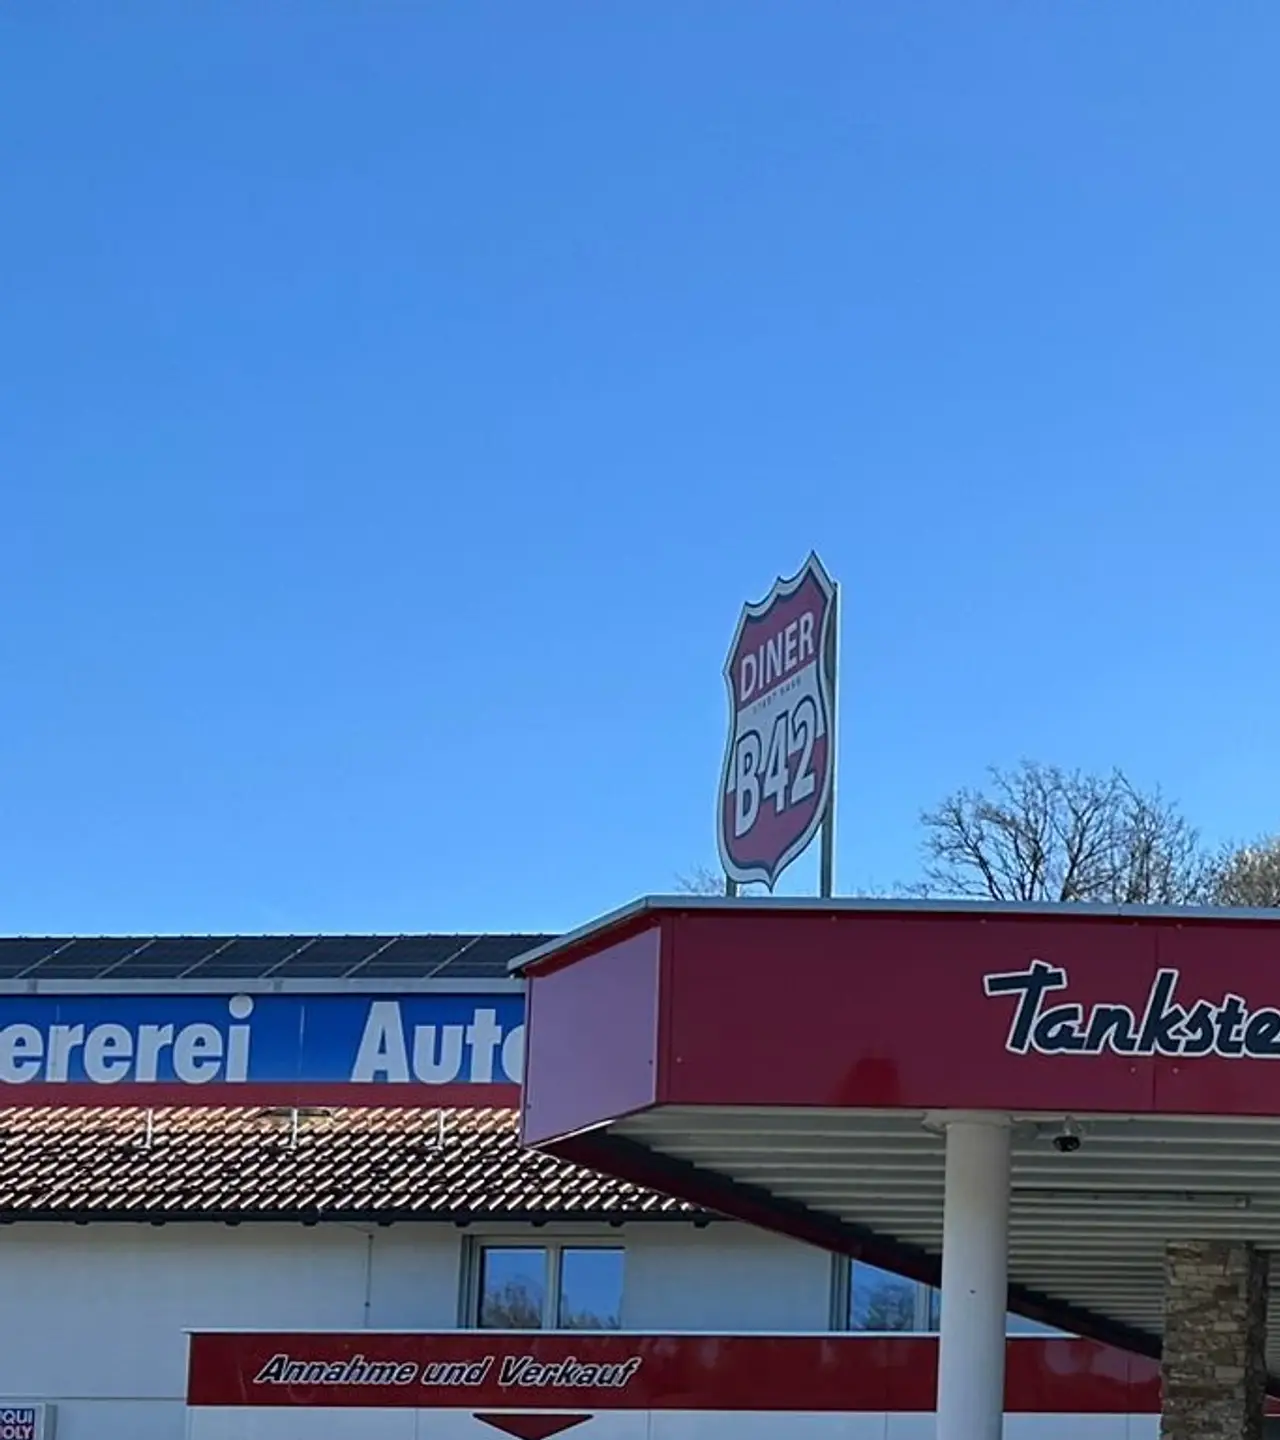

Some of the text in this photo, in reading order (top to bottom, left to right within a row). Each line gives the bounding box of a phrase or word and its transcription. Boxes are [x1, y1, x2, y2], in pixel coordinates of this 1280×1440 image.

[741, 612, 815, 702] DINER
[735, 694, 818, 839] B42
[0, 995, 254, 1084] ererei
[253, 1354, 643, 1386] Annahme und Verkauf
